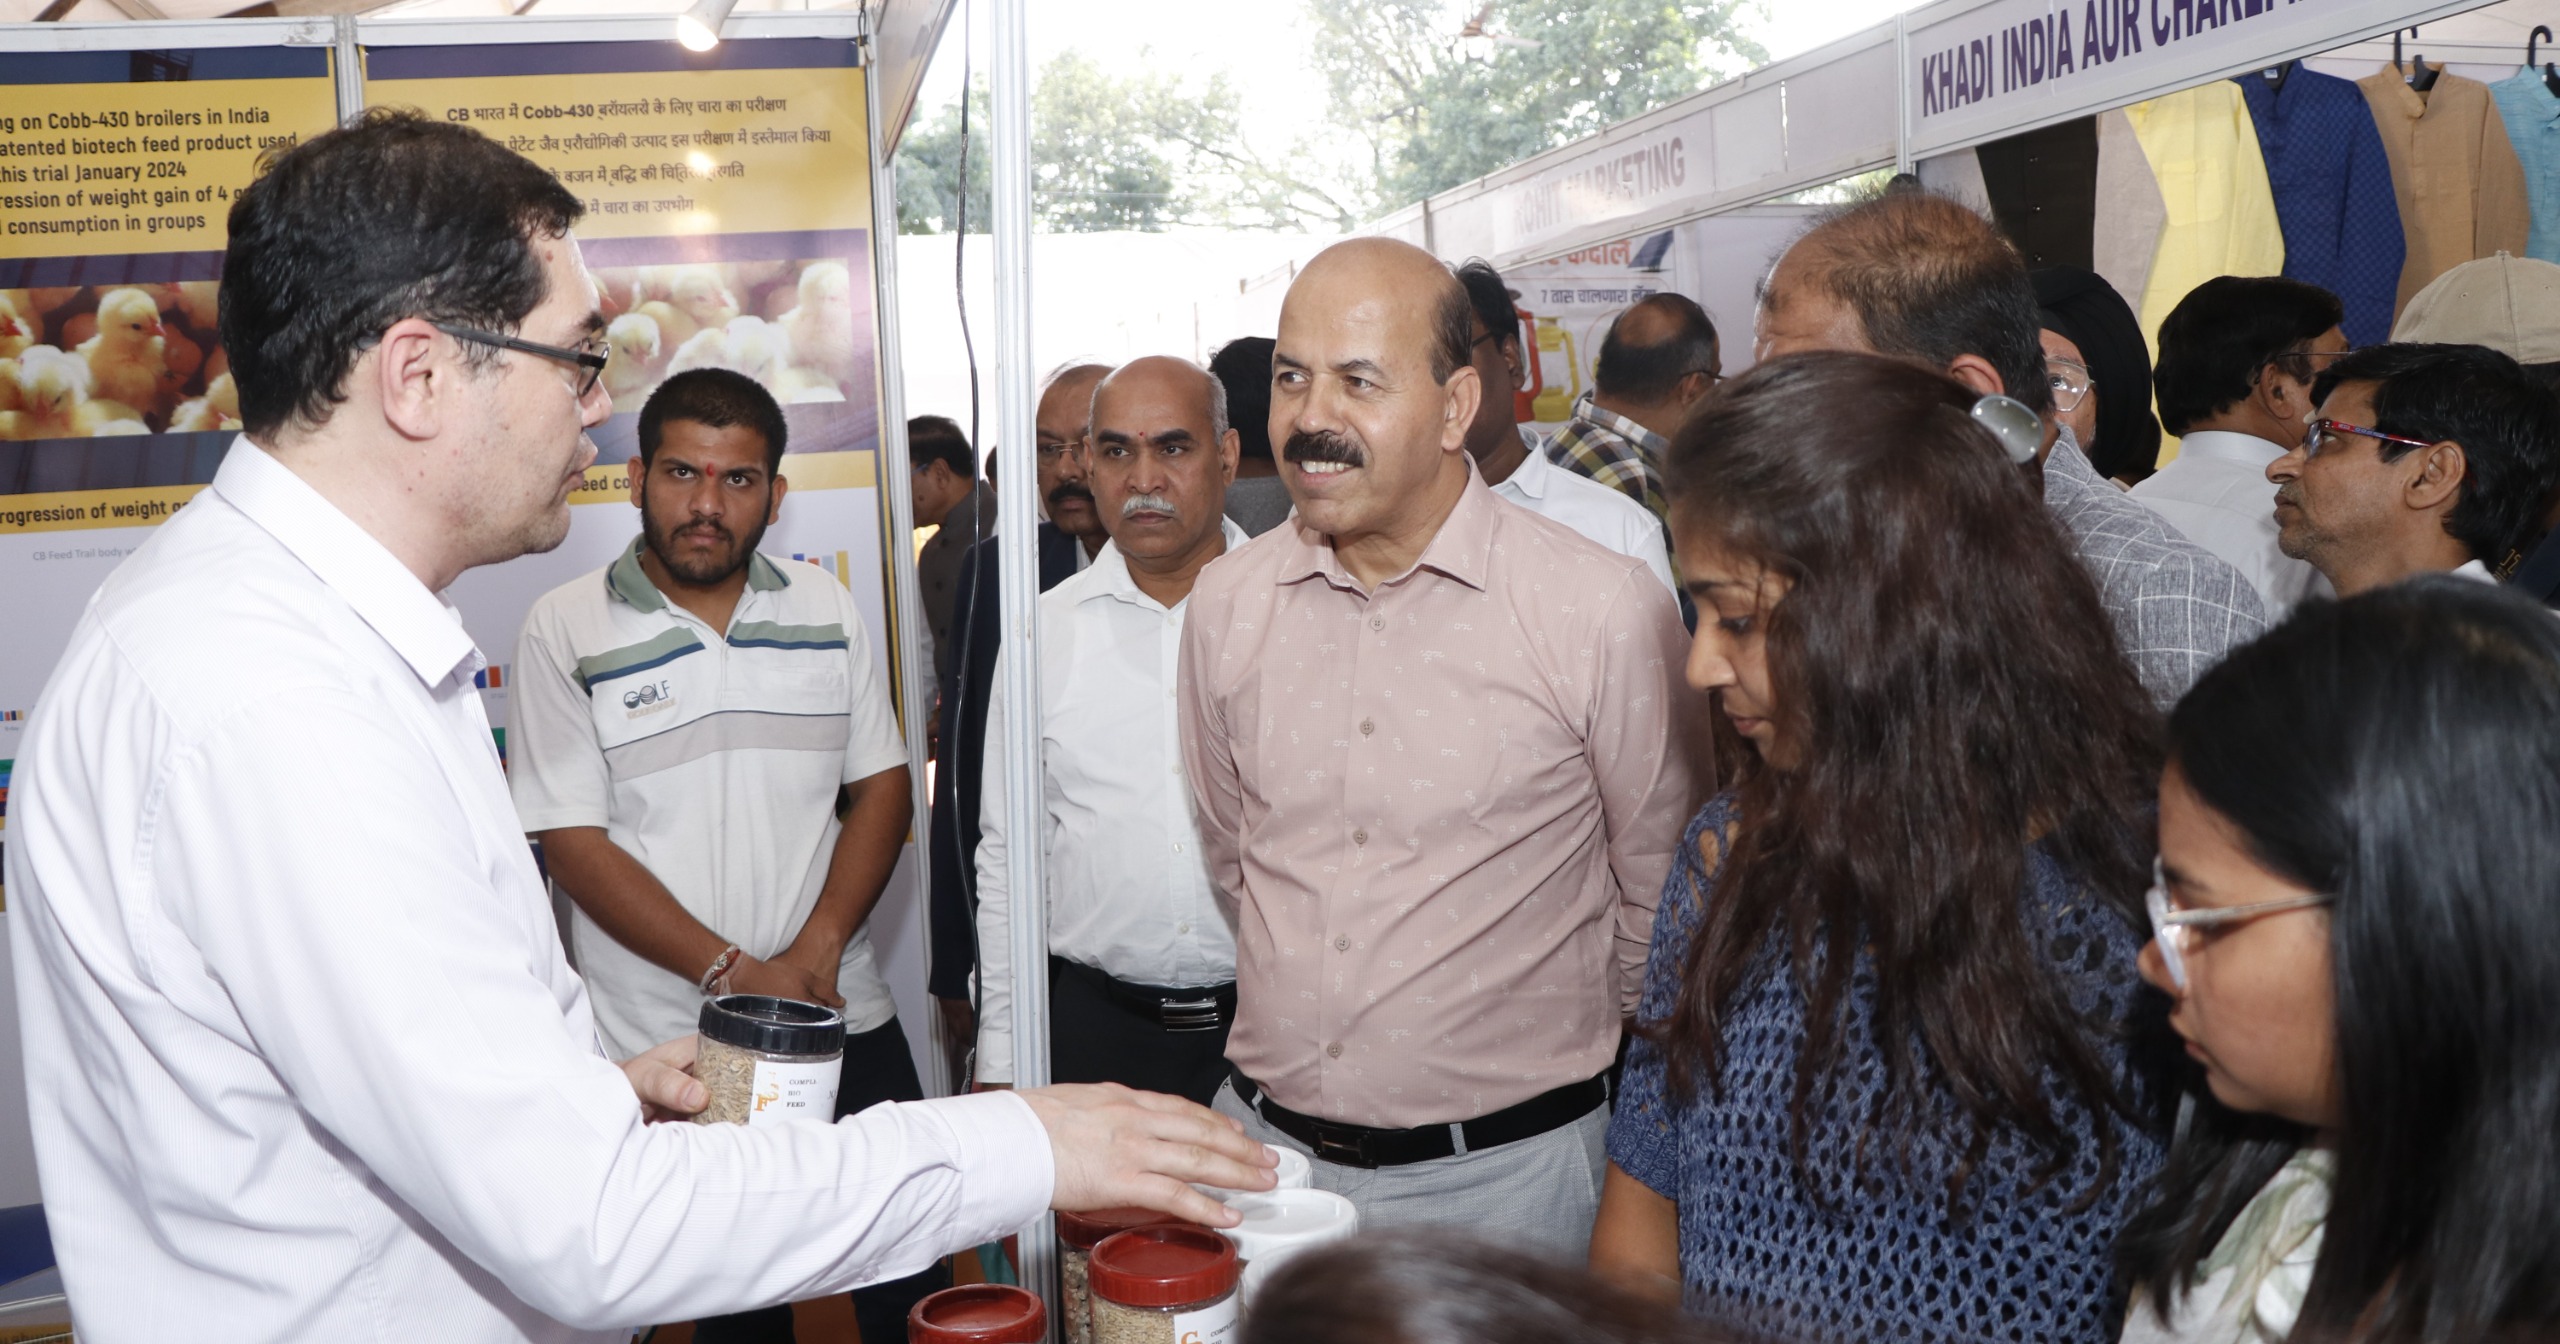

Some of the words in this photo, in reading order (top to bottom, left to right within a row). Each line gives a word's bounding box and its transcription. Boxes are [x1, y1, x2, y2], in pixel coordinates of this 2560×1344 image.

[1922, 35, 1994, 117] KHADI
[2003, 9, 2074, 93] INDIA
[2082, 0, 2142, 70] AUR
[21, 117, 42, 131] on
[48, 111, 129, 130] Cobb-430
[135, 109, 201, 127] broilers
[207, 108, 222, 125] in
[228, 107, 270, 124] India
[447, 108, 470, 122] CB
[473, 107, 505, 121] भारत
[523, 104, 594, 119] Cobb-430
[653, 98, 665, 114] के
[669, 97, 693, 115] लिए
[725, 99, 742, 113] का
[746, 96, 787, 113] परीक्षण
[72, 136, 136, 155] biotech
[142, 135, 180, 152] feed
[186, 134, 252, 155] product
[258, 131, 297, 149] used
[631, 134, 667, 149] उत्पाद
[671, 134, 689, 148] इस
[693, 129, 734, 146] परीक्षण
[751, 127, 798, 146] इस्तेमाल
[801, 126, 832, 144] किया
[33, 164, 68, 182] trial
[75, 163, 141, 184] January
[147, 161, 187, 178] 2024
[640, 164, 657, 180] की
[67, 190, 83, 207] of
[89, 188, 147, 208] weight
[154, 186, 189, 207] gain
[196, 186, 212, 202] of
[218, 185, 229, 201] 4
[633, 199, 649, 213] का
[8, 215, 119, 236] consumption
[126, 213, 141, 231] in
[147, 213, 205, 233] groups
[1551, 289, 1574, 303] तास
[91, 502, 107, 519] of
[112, 499, 167, 519] weight
[48, 550, 72, 560] Feed
[75, 549, 95, 559] Trail
[98, 547, 123, 559] body
[623, 679, 671, 709] GOLF
